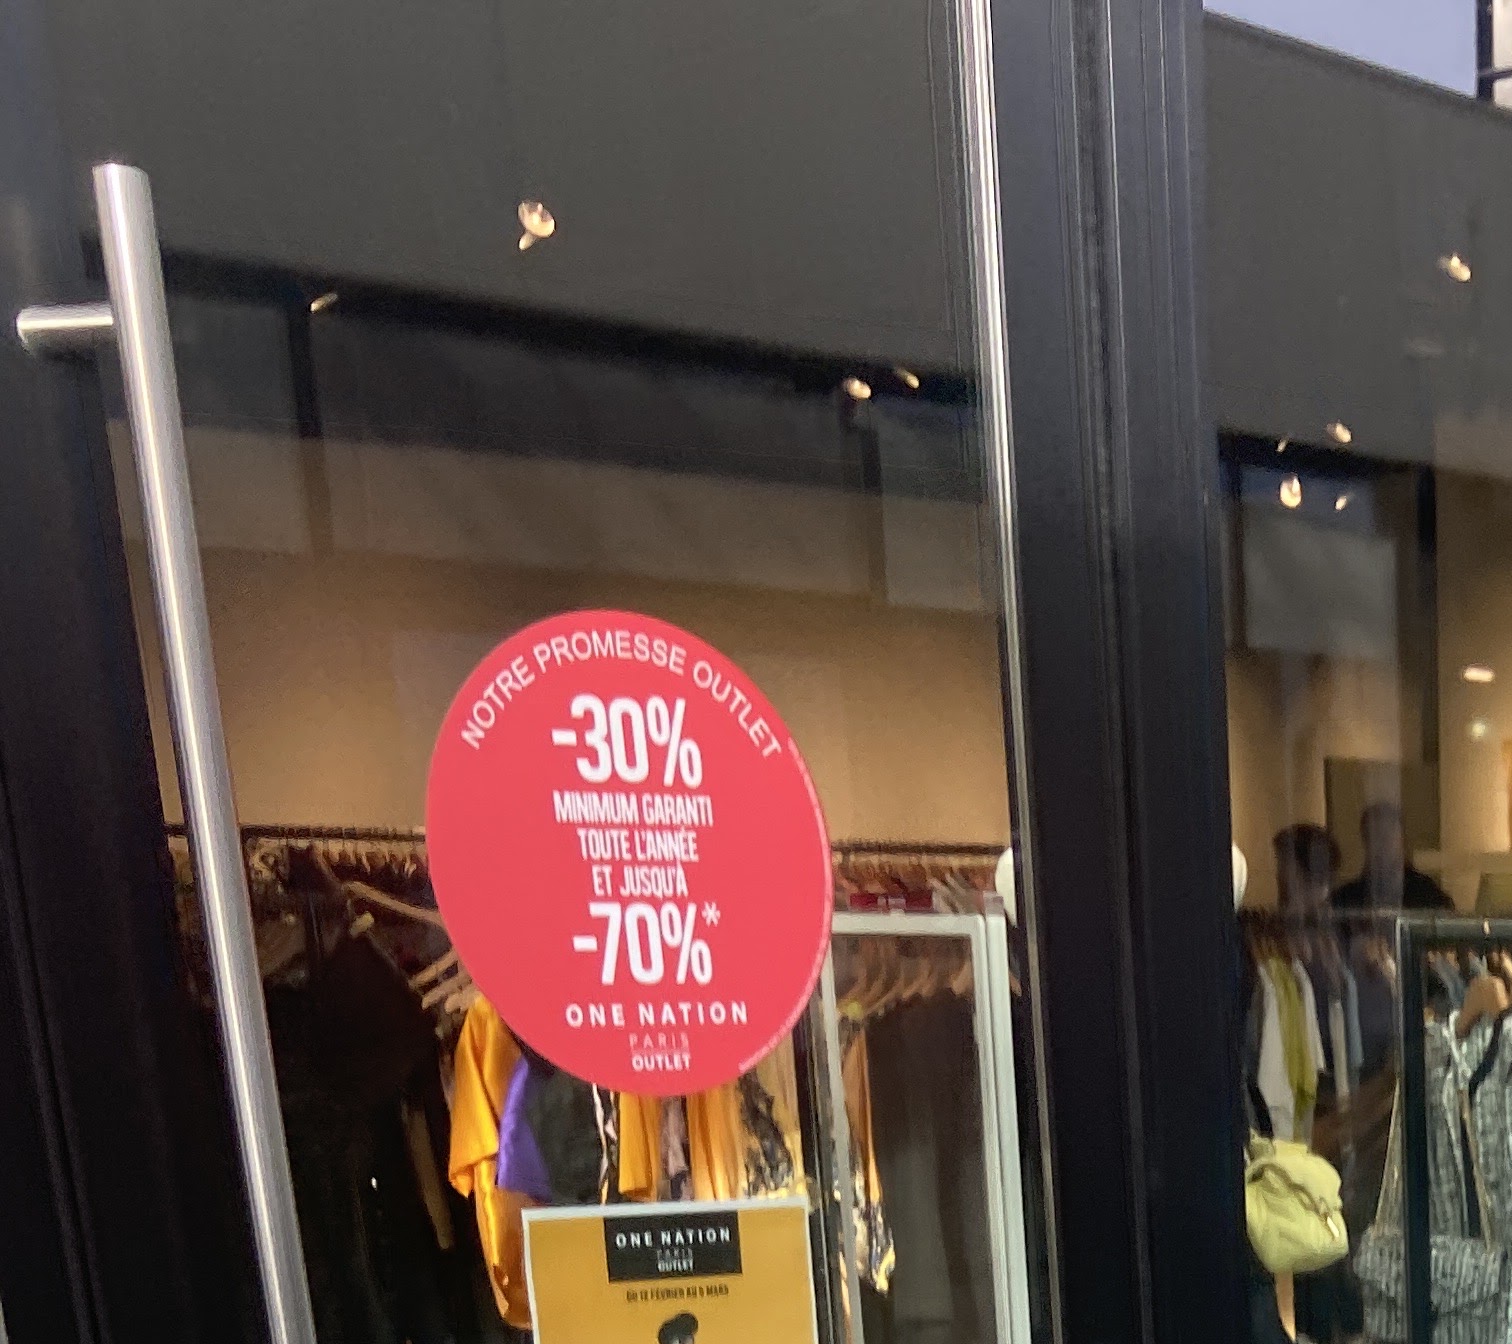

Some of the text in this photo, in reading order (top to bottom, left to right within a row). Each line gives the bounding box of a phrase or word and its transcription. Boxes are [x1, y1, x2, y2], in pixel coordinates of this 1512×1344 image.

[460, 629, 782, 758] NOTRE PROMESSE OUTLET
[552, 693, 703, 788] -30%
[552, 789, 714, 828] MINIMUM GARANTI
[576, 826, 700, 863] TOUTE L'ANNÉE
[591, 864, 613, 898] ET
[565, 1000, 749, 1029] ONE NATION
[628, 1031, 690, 1050] PARIS
[631, 1051, 692, 1073] OUTLET
[615, 1226, 731, 1250] ONE NATION
